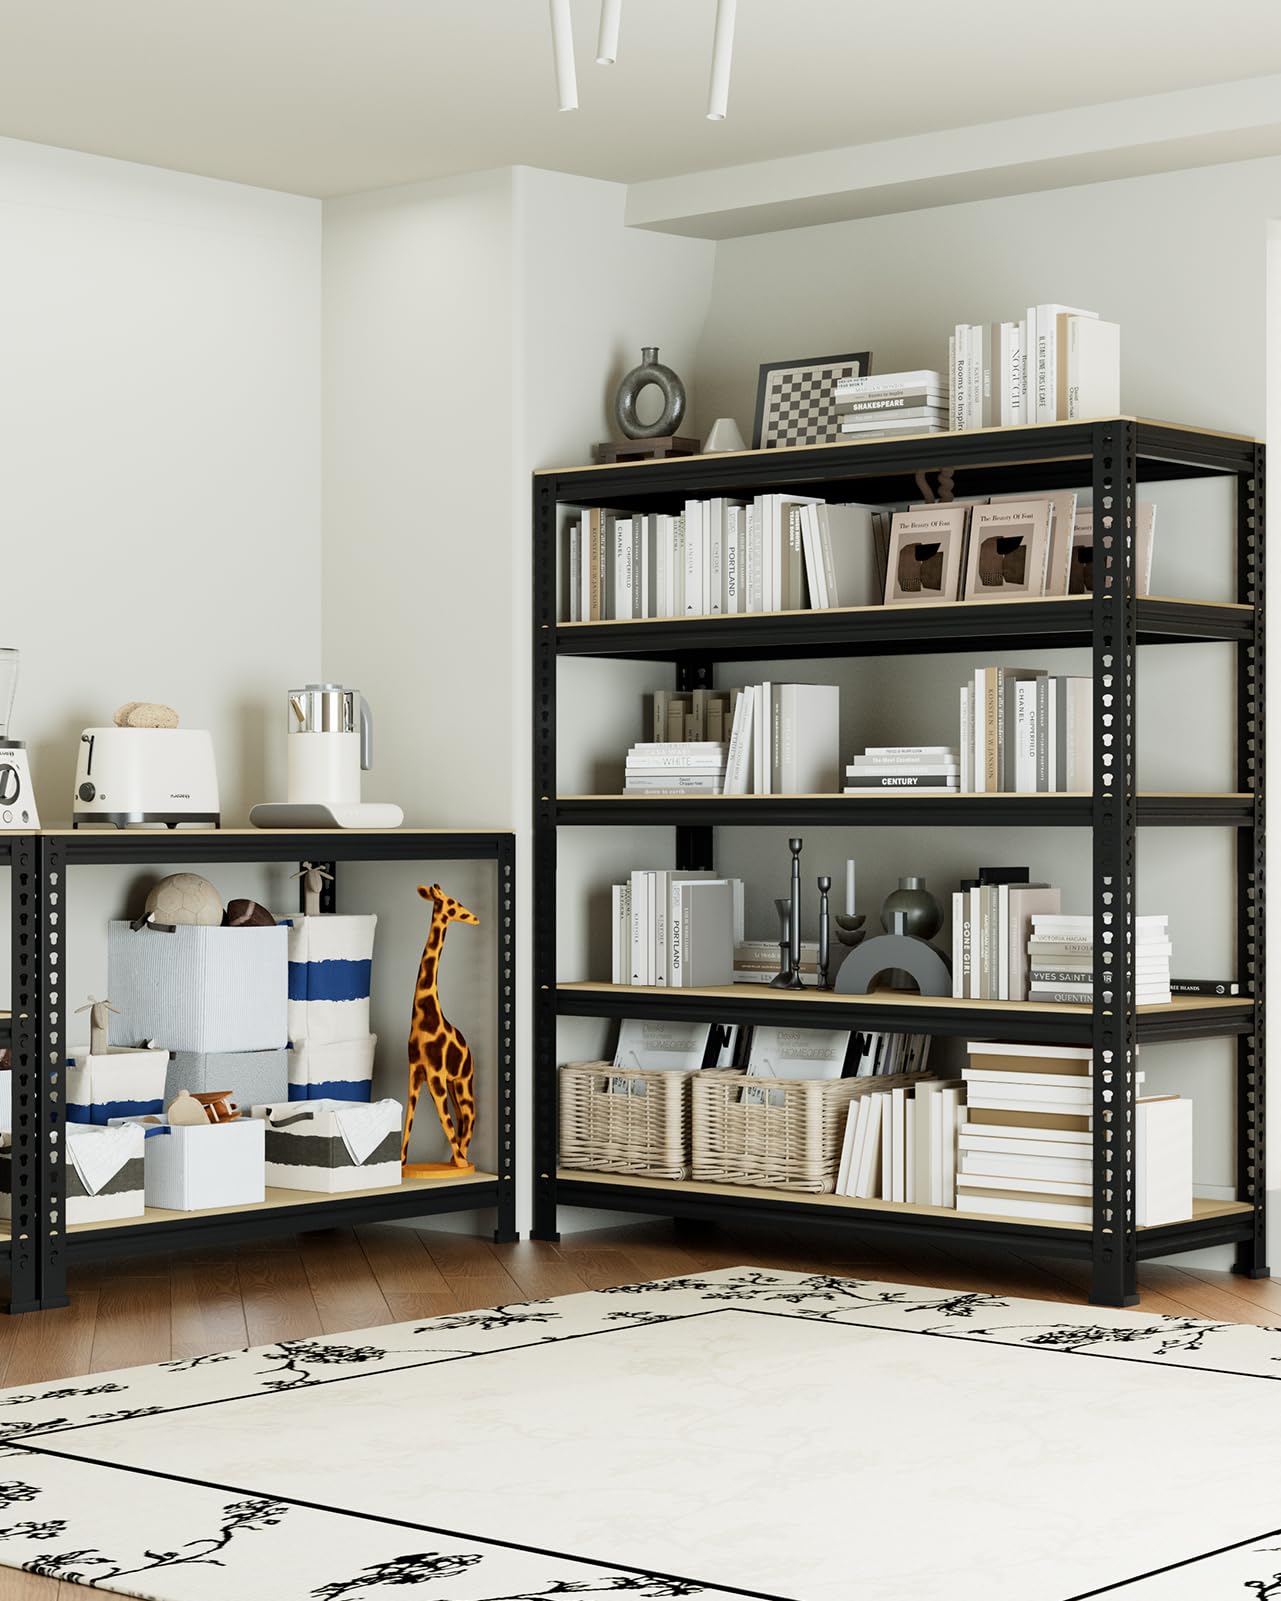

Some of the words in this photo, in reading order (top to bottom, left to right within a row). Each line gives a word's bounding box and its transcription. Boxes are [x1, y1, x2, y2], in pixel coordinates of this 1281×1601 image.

[957, 360, 965, 390] Rooms
[853, 398, 905, 411] SHAKESPEARE
[957, 391, 965, 401] to
[728, 546, 736, 597] PORTLAND
[988, 688, 996, 725] KONSTEN
[881, 777, 919, 785] CENTURY
[963, 921, 971, 950] GONE
[963, 953, 971, 975] GIRL
[1033, 972, 1057, 981] YVES
[1059, 973, 1086, 982] SAINT
[1054, 993, 1093, 1003] QUENTIN
